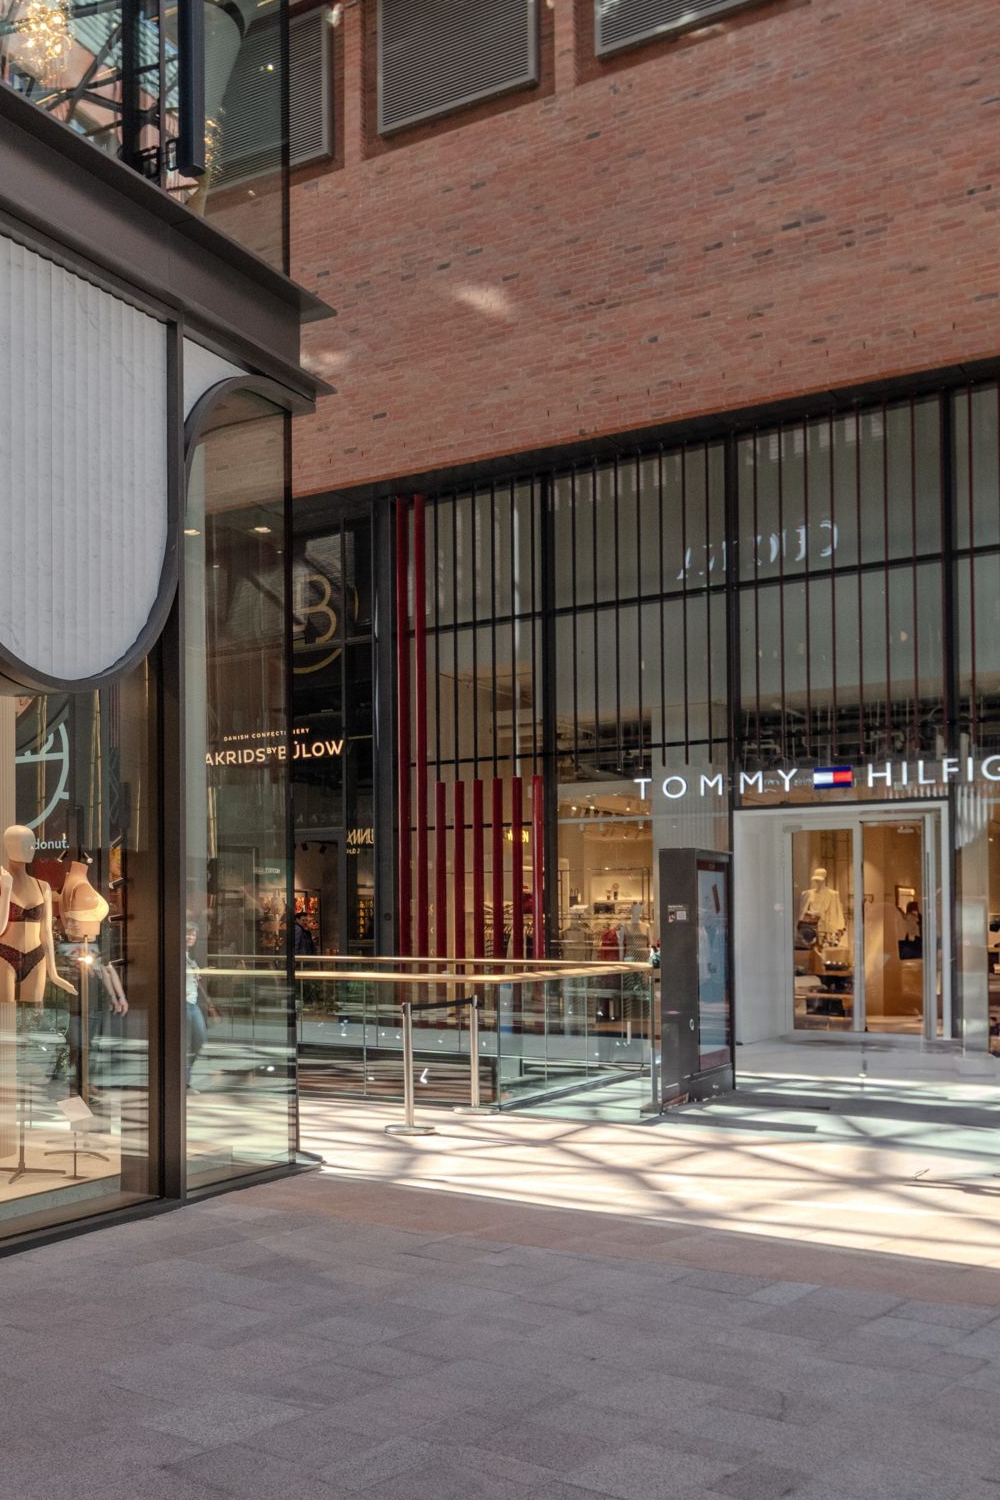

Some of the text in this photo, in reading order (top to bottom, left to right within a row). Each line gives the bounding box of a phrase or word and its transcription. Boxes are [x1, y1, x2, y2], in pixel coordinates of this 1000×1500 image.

[223, 727, 310, 742] DANISH CONFECTIERY
[205, 747, 266, 766] AKRIDS
[634, 767, 798, 800] TOMMY
